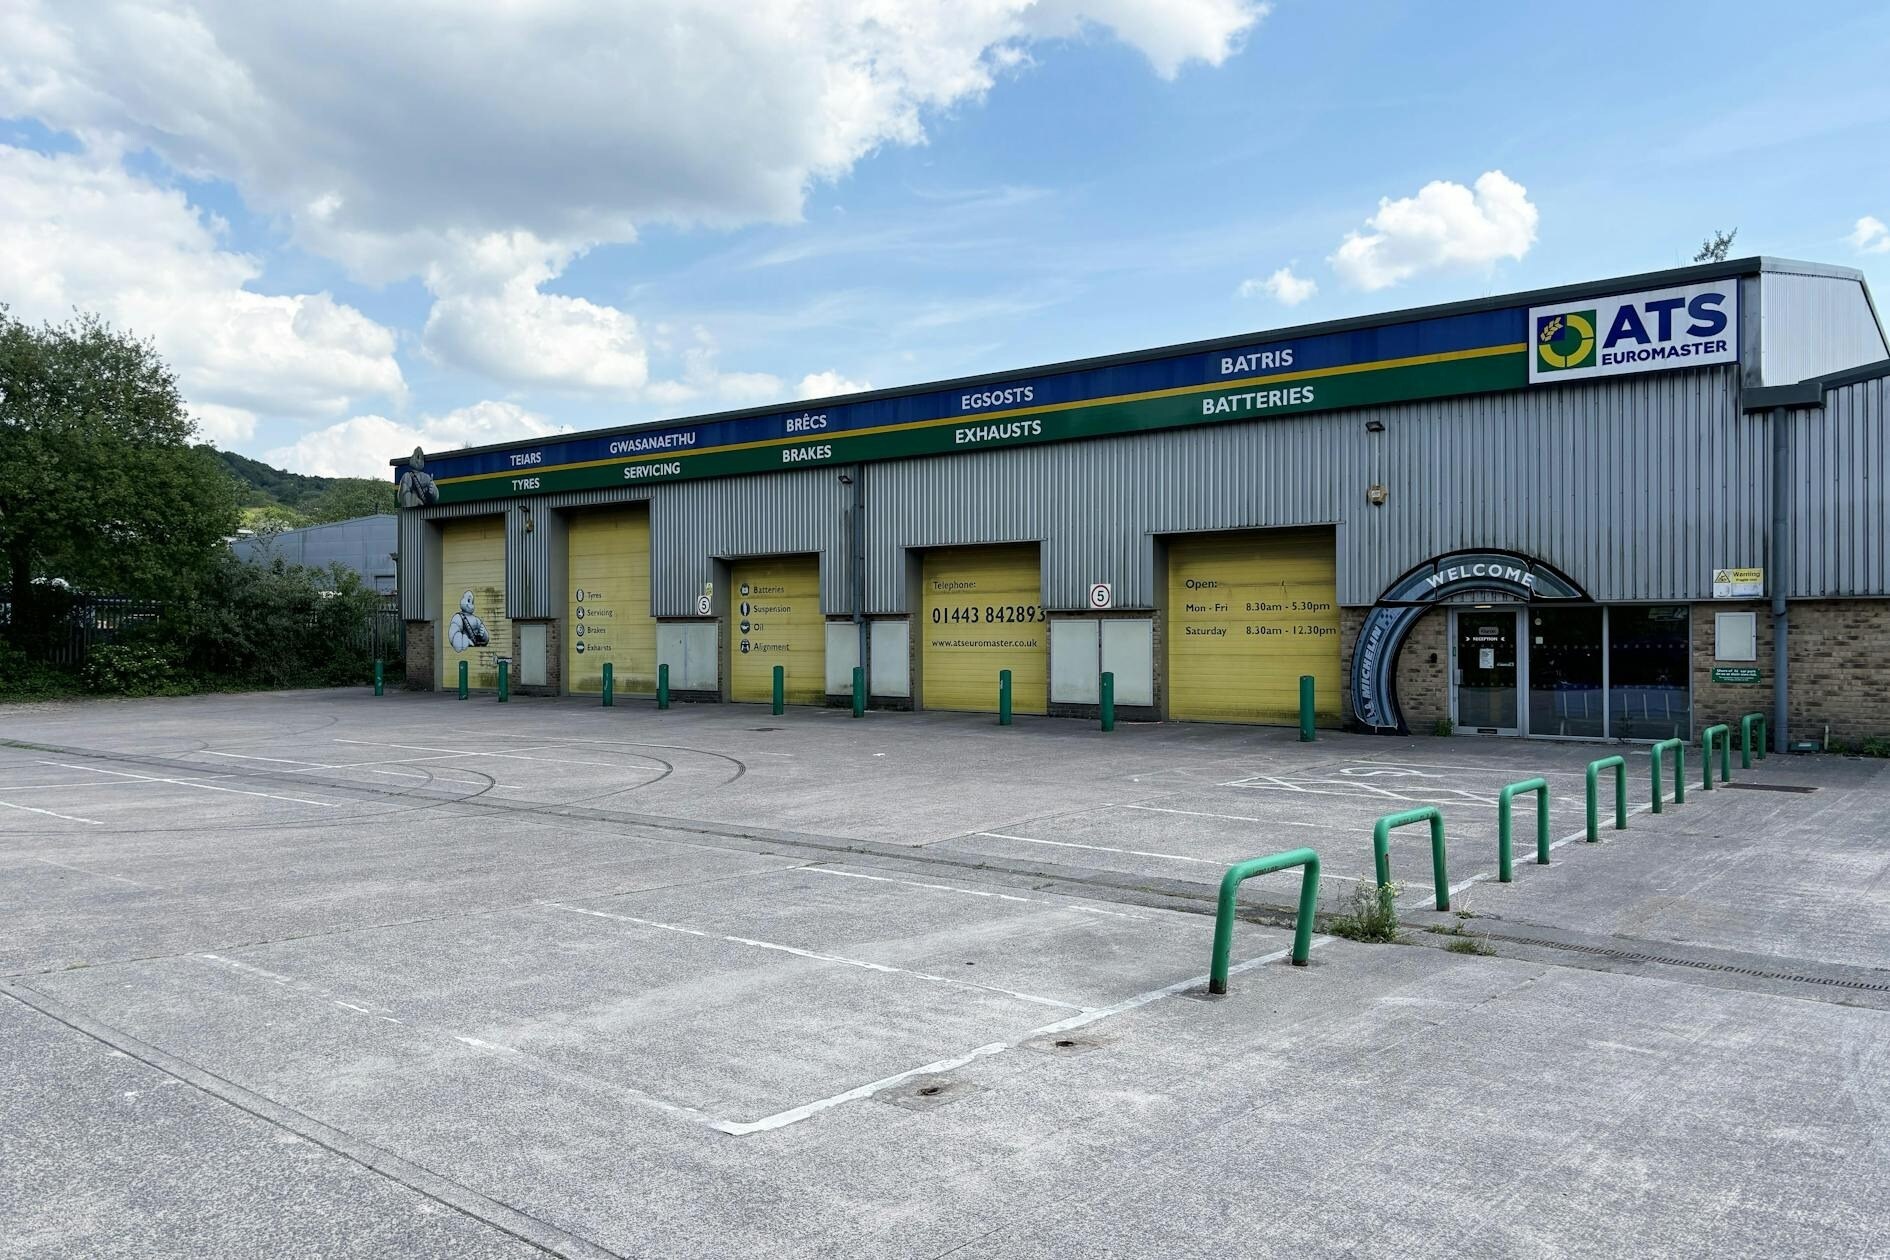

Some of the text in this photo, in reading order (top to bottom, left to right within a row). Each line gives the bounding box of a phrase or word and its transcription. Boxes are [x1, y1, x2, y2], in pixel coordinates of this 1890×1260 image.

[1602, 292, 1728, 349] ATS
[1602, 339, 1728, 366] EUROMASTER
[1220, 348, 1294, 375] BATRIS
[961, 386, 1034, 410] EGSOSTS
[1202, 385, 1315, 415] BATTERIES
[786, 413, 827, 433] BRÊCS
[955, 420, 1042, 444] EXHAUSTS
[609, 432, 696, 454] GWASANAETHU
[510, 451, 542, 467] TEIARS
[782, 445, 832, 463] BRAKES
[623, 462, 681, 479] SERVICING
[512, 477, 540, 491] TYRES
[1425, 563, 1536, 588] WELCOME
[753, 586, 785, 594] Batteries
[933, 581, 977, 590] Telephone:
[1185, 579, 1218, 591] Open:
[587, 592, 602, 600] Tyres
[1096, 590, 1105, 602] 5
[701, 600, 707, 610] 5
[753, 606, 791, 614] Suspension
[1185, 603, 1206, 612] Mon
[1215, 603, 1228, 612] Fri
[1246, 603, 1282, 612] 8.30am
[1291, 602, 1331, 613] 5.30pm
[587, 609, 613, 617] Servicing
[932, 605, 1047, 624] 01443 842893
[587, 626, 606, 634] Brakes
[753, 623, 764, 631] Oil
[1185, 626, 1227, 636] Saturday
[1246, 626, 1282, 635] 8.30am
[1293, 625, 1337, 636] 12.30pm
[753, 642, 790, 652] Alignment
[932, 638, 1037, 648] www.atseuromaster.co.uk
[1361, 625, 1383, 699] MICHELIN
